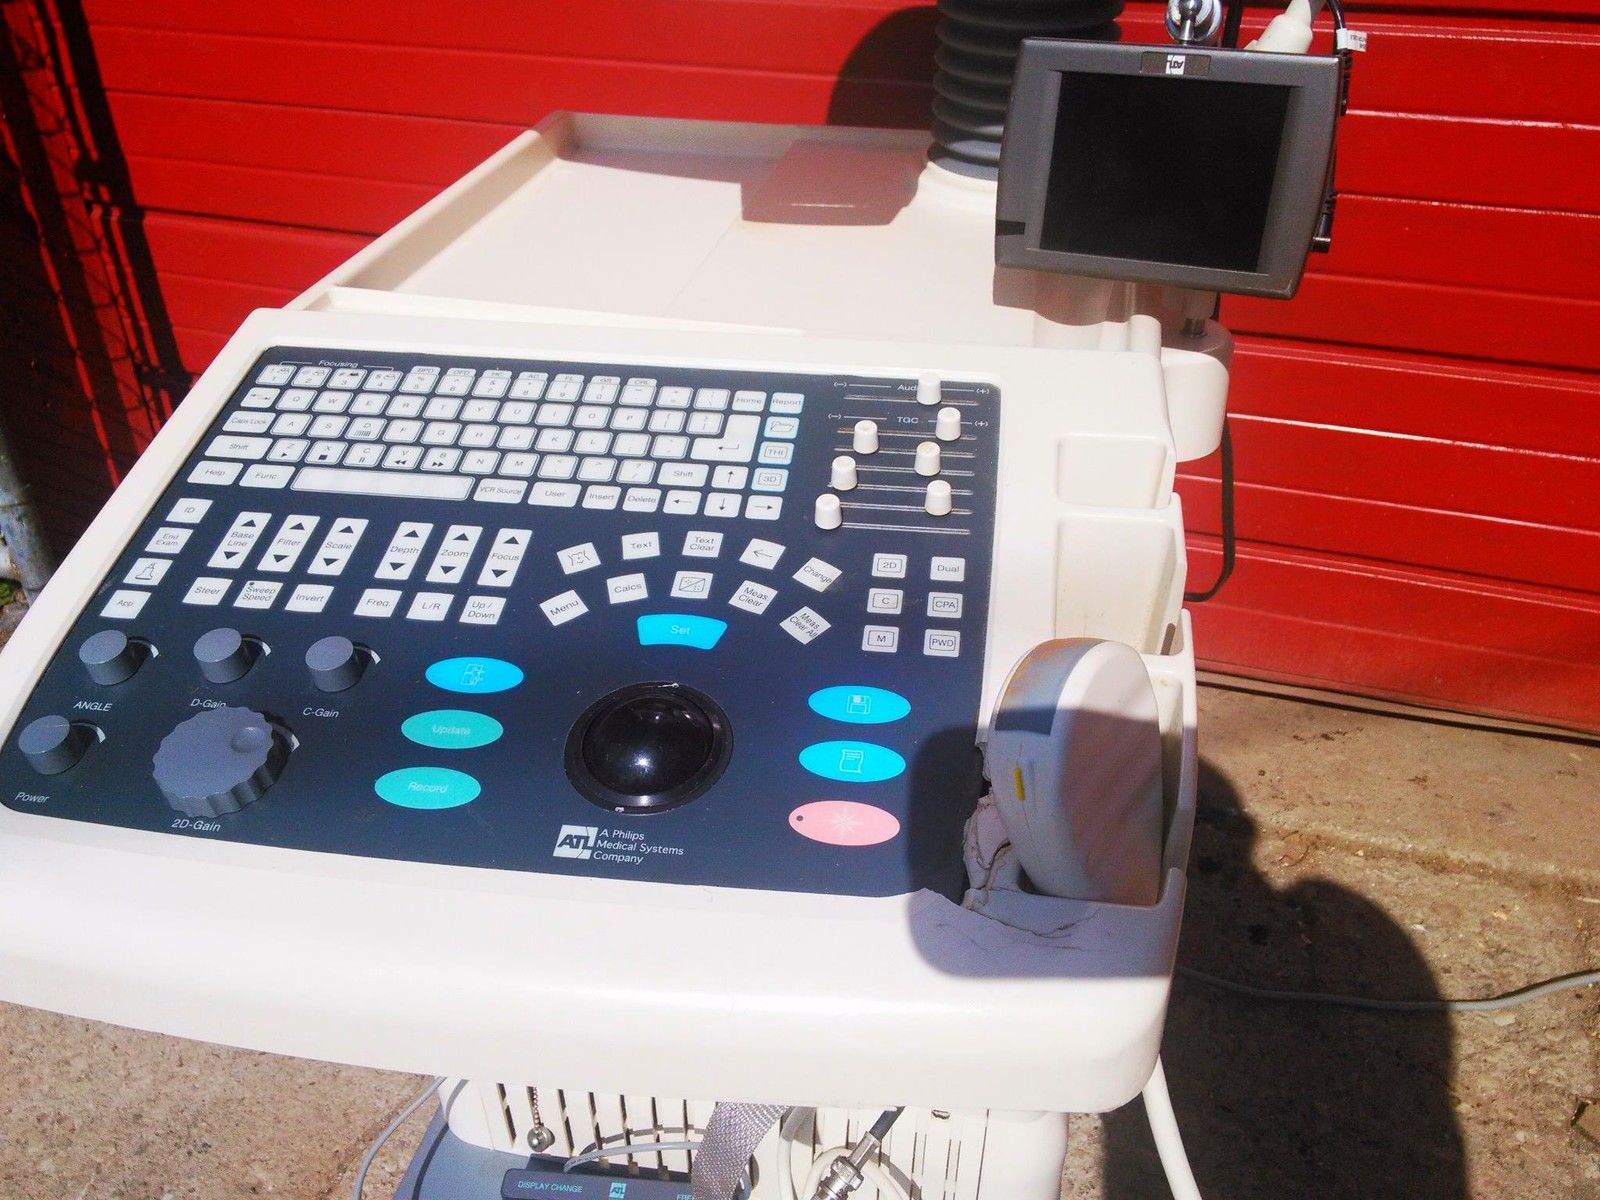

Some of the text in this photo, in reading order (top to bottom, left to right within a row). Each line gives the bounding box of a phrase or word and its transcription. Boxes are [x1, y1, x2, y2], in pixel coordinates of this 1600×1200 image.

[318, 360, 359, 369] Focusing
[897, 384, 918, 392] Aud
[773, 399, 801, 407] Report
[231, 416, 249, 425] Caps
[897, 416, 919, 425] TGC
[205, 469, 225, 477] Help
[496, 487, 522, 495] Source
[588, 493, 616, 501] Insert
[627, 495, 657, 503] Delete
[162, 532, 180, 540] End
[230, 531, 255, 539] Base
[155, 539, 179, 547] Exam
[227, 539, 248, 547] Line
[277, 538, 301, 547] Filter
[695, 536, 714, 544] Text
[325, 541, 353, 550] Scale
[390, 545, 420, 555] Depth
[631, 541, 652, 550] Text
[689, 543, 715, 552] Clear
[440, 549, 469, 557] Zoom
[491, 552, 520, 561] Focus
[882, 561, 897, 569] 2D
[937, 564, 960, 573] Dual
[803, 564, 833, 584] Change
[194, 586, 221, 595] Steer
[246, 586, 276, 595] Sweep
[613, 584, 642, 594] Calcs
[242, 593, 273, 602] Speed
[296, 593, 324, 602] Invert
[738, 594, 763, 608] Clear
[366, 599, 391, 608] Freq.
[422, 602, 441, 610] L/R
[472, 601, 486, 609] Up
[549, 600, 579, 616] Menu
[935, 600, 956, 609] CPA
[467, 610, 495, 619] Down
[670, 624, 691, 635] Set
[789, 616, 819, 639] Clear All
[931, 638, 954, 647] PWD
[73, 700, 113, 712] ANGLE
[190, 698, 227, 708] D-Gain
[302, 707, 340, 718] C-Gain
[432, 724, 471, 736] Update
[408, 782, 450, 794] Record
[15, 791, 50, 804] Power
[171, 818, 221, 832] 2D-Gain
[598, 828, 645, 841] A Philips
[557, 834, 594, 850] ATL
[596, 840, 684, 856] Medical Systems
[593, 851, 644, 865] Company
[518, 1181, 583, 1193] DISPLAY CHANGE
